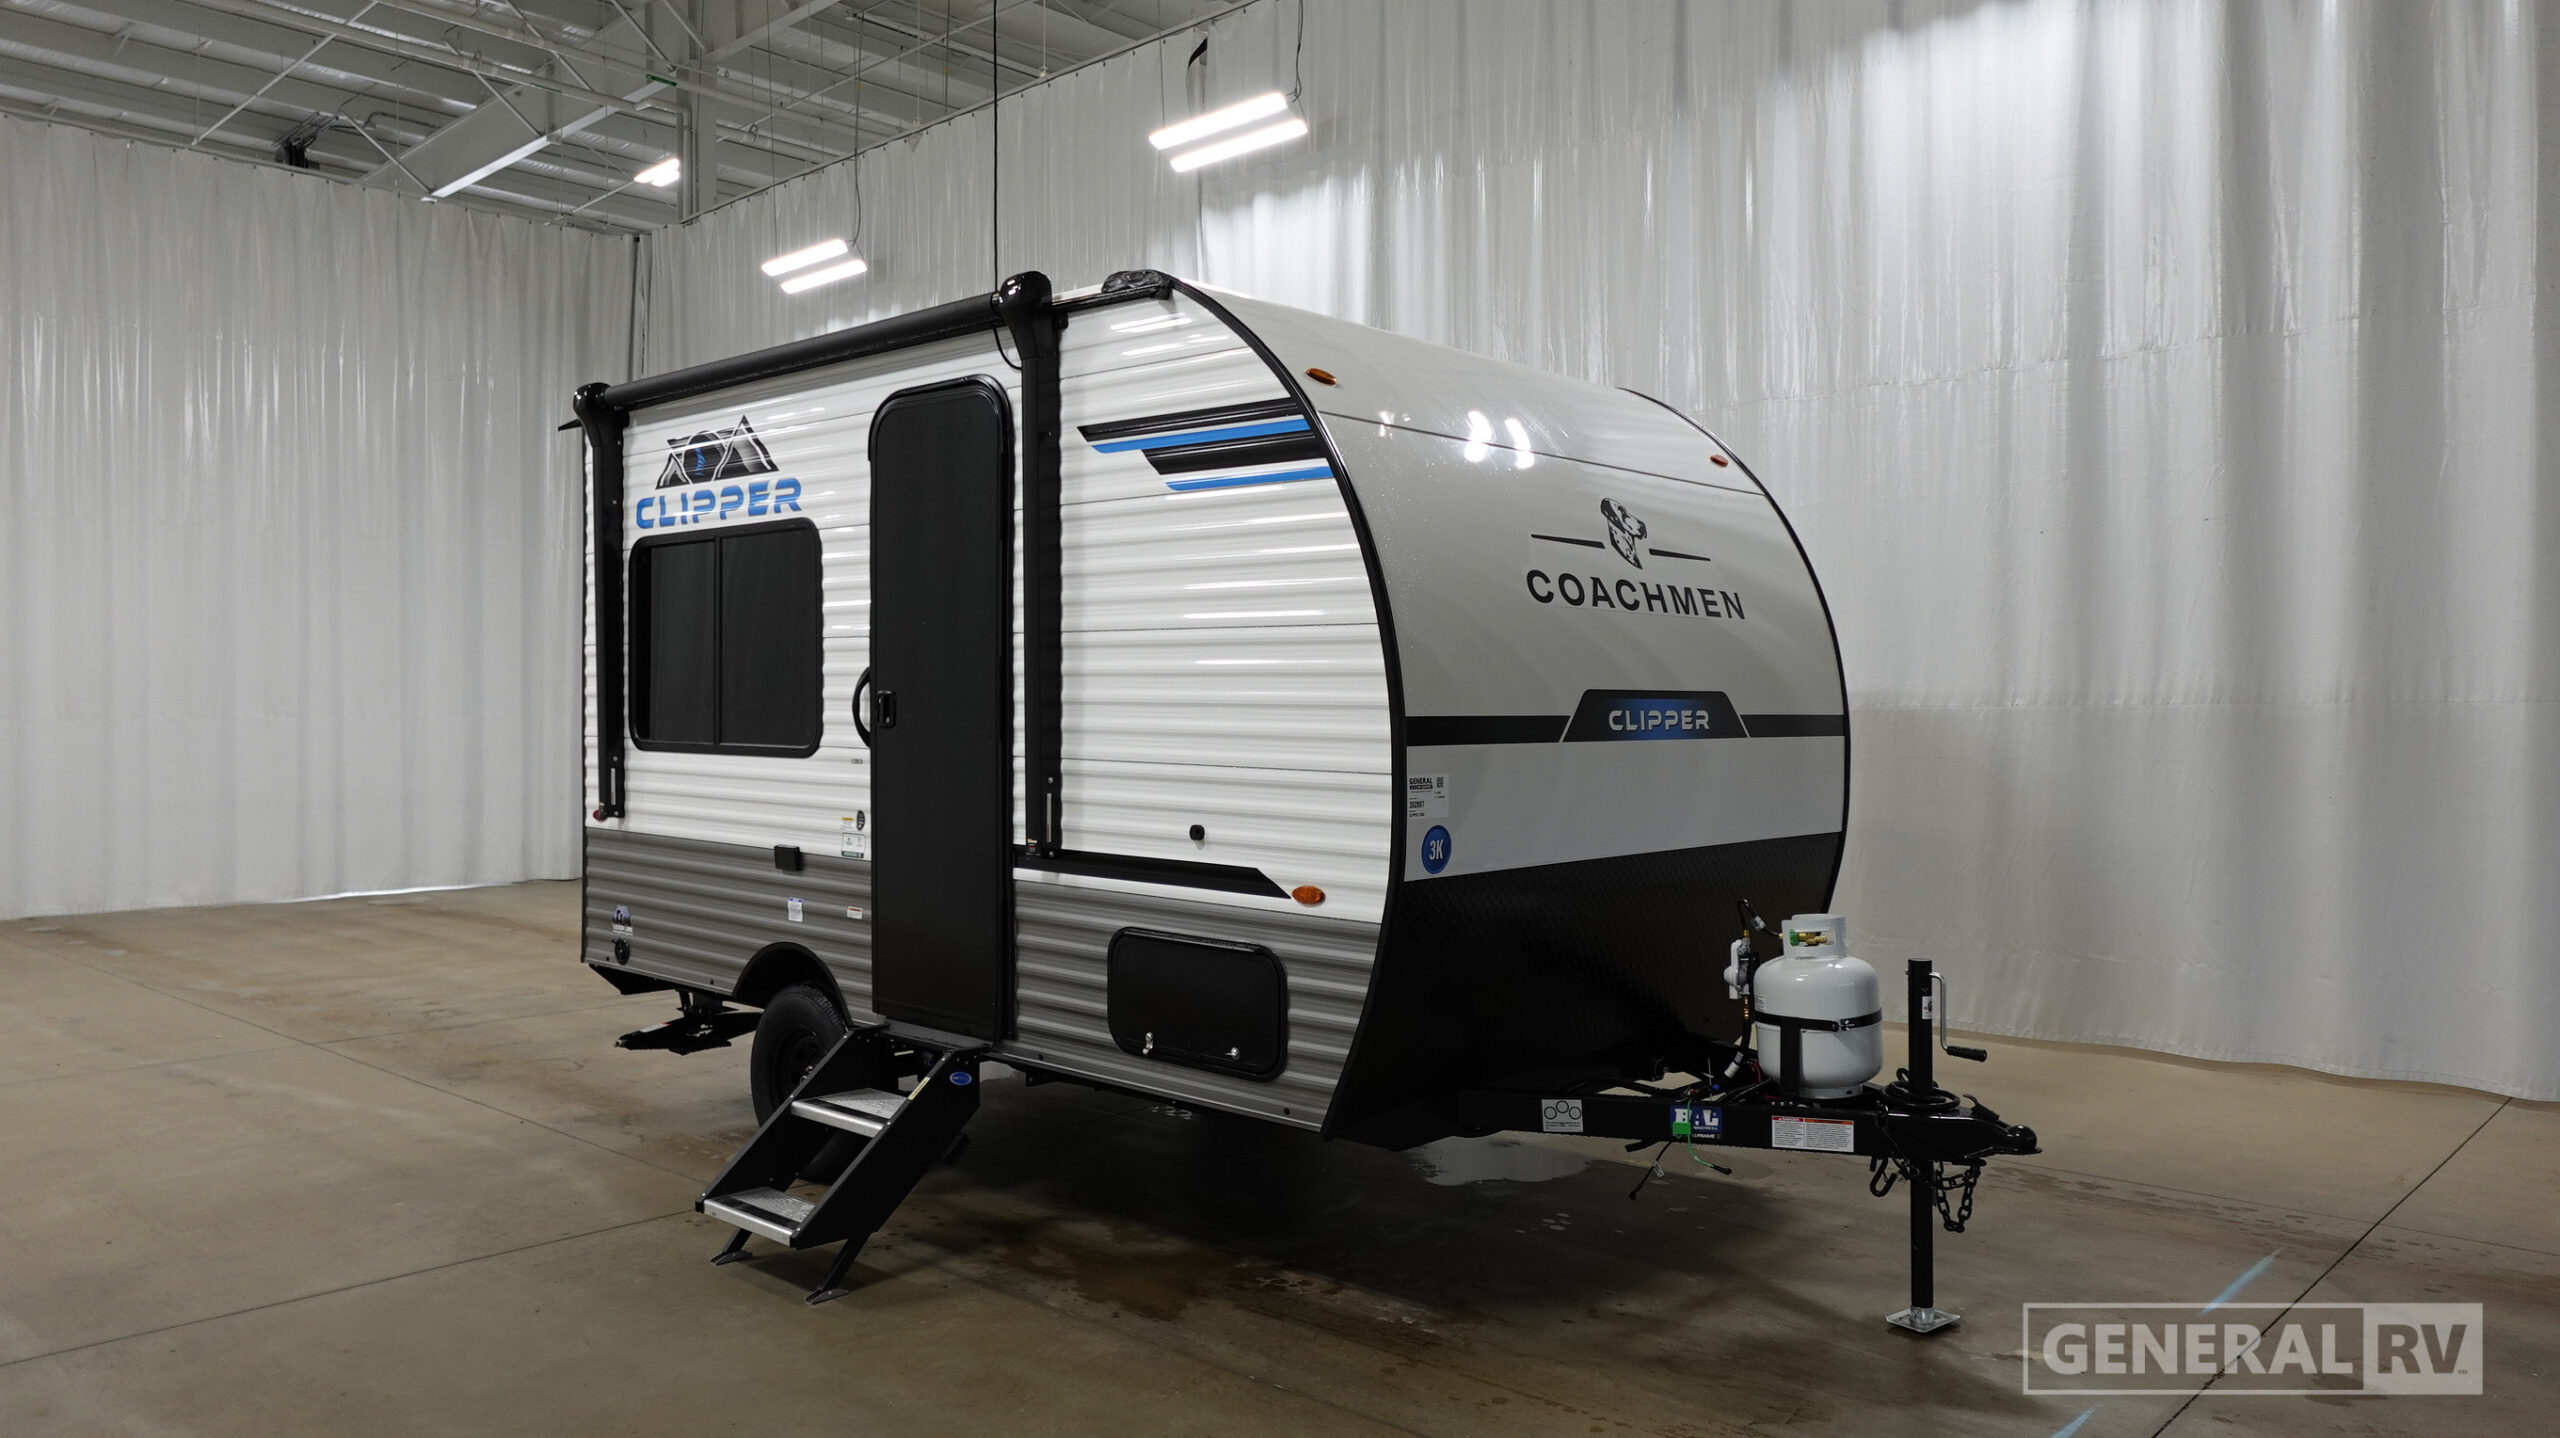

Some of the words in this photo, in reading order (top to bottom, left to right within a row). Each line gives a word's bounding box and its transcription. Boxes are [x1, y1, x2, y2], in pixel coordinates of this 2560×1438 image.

[636, 478, 802, 529] CLIPPER
[1526, 569, 1745, 619] COACHMEN
[1608, 710, 1710, 731] CLIPPER
[1429, 839, 1444, 860] 3K
